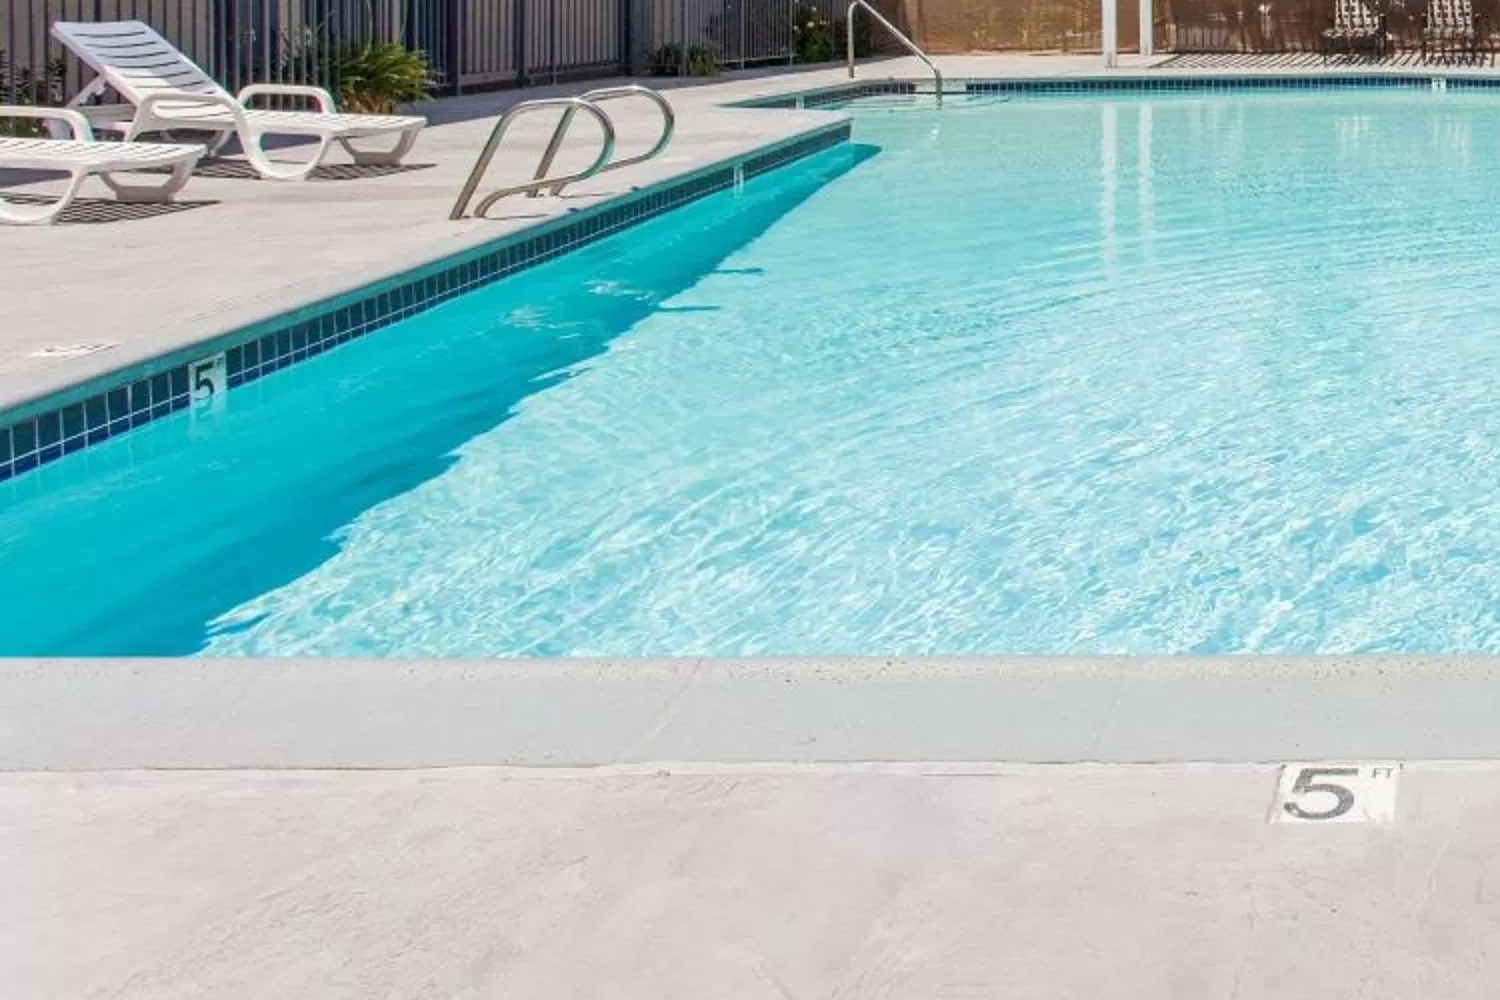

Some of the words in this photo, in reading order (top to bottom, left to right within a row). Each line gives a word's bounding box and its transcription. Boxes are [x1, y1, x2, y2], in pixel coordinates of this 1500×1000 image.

[195, 361, 215, 400] 5
[1283, 767, 1359, 820] 5
[1372, 767, 1394, 779] FT
